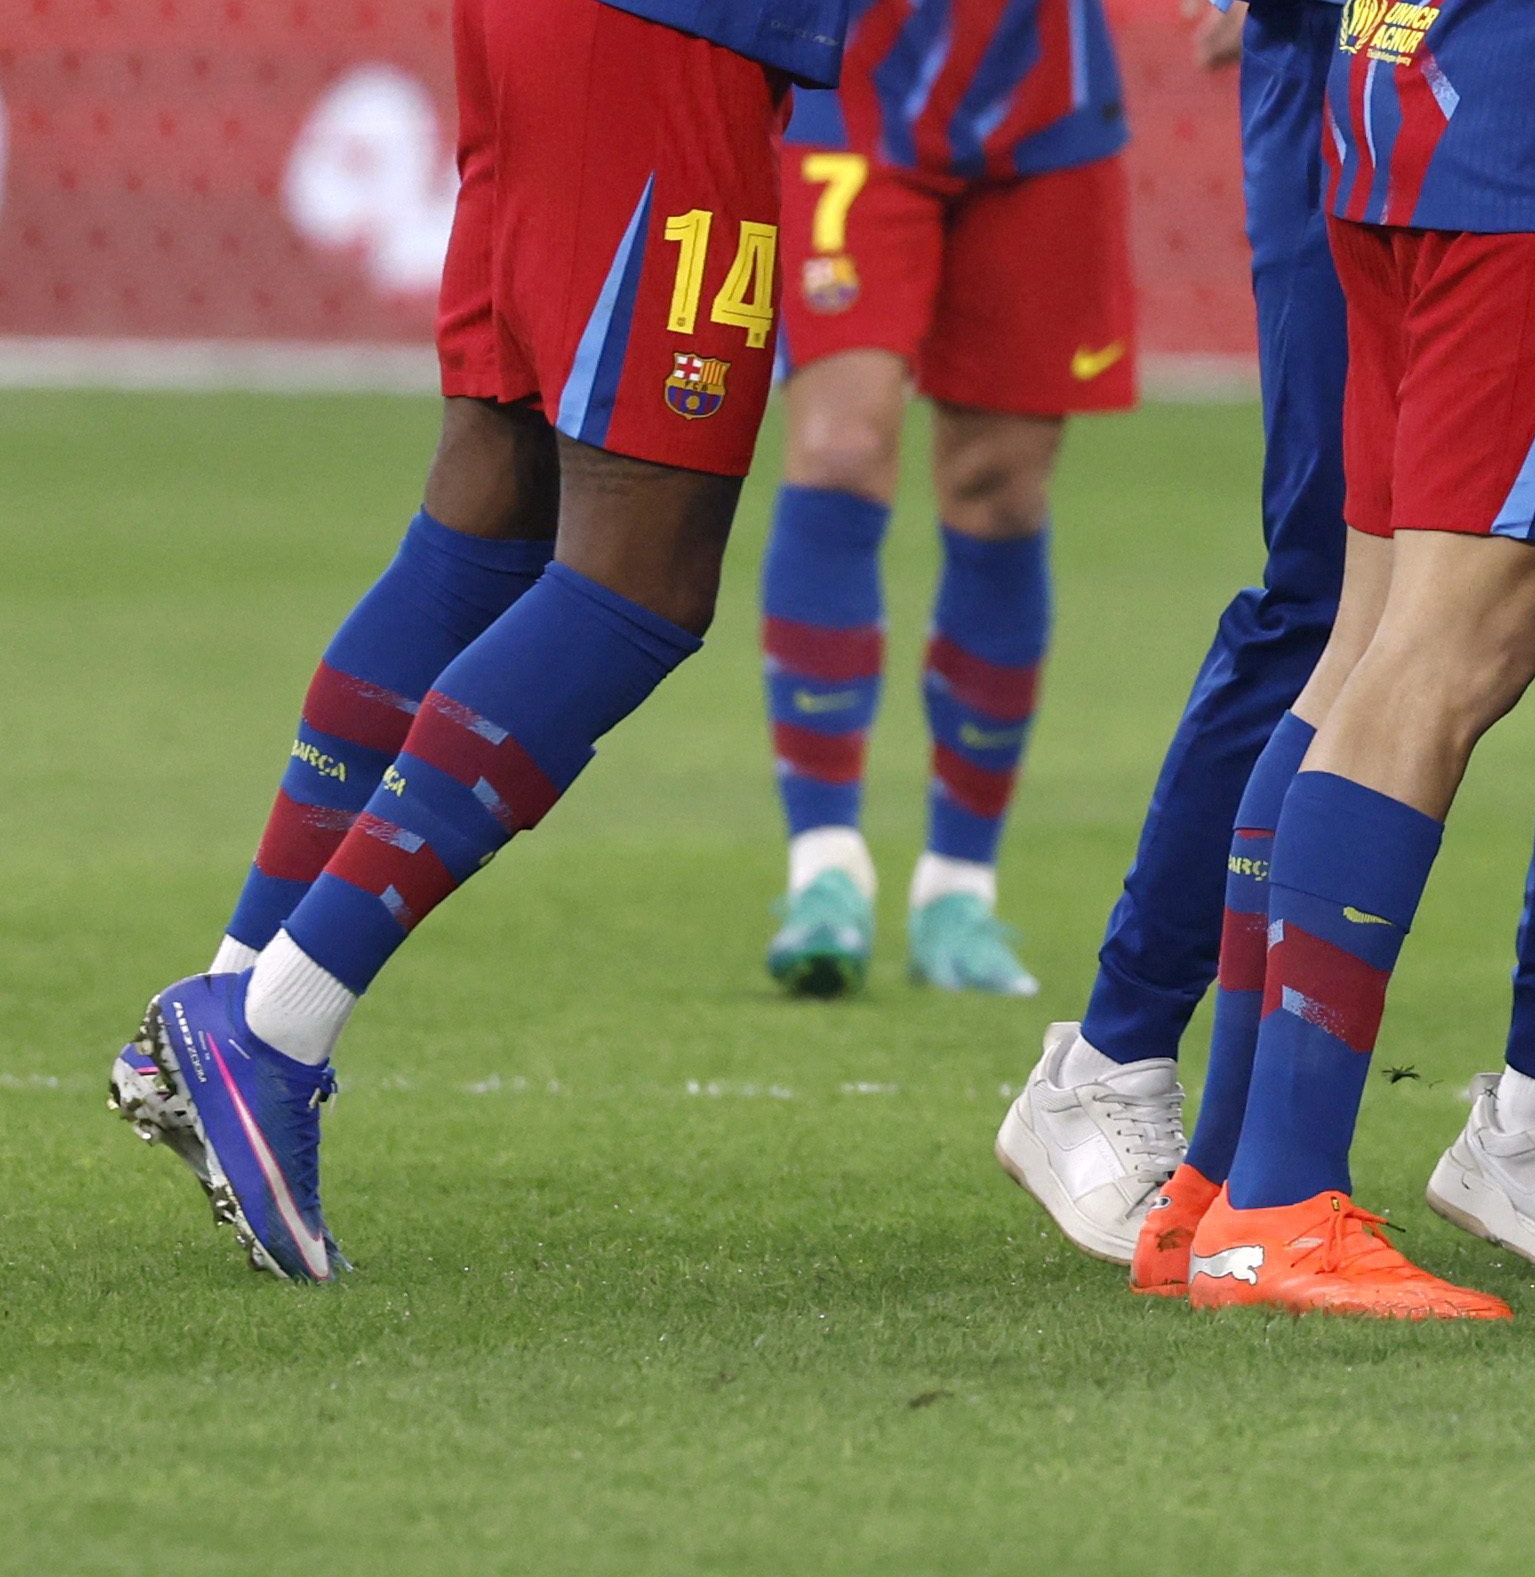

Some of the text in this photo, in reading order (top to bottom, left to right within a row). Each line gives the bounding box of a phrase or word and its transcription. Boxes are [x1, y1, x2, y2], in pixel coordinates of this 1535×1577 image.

[1369, 24, 1425, 54] ACNUR
[803, 155, 868, 254] 7
[664, 208, 779, 349] 14
